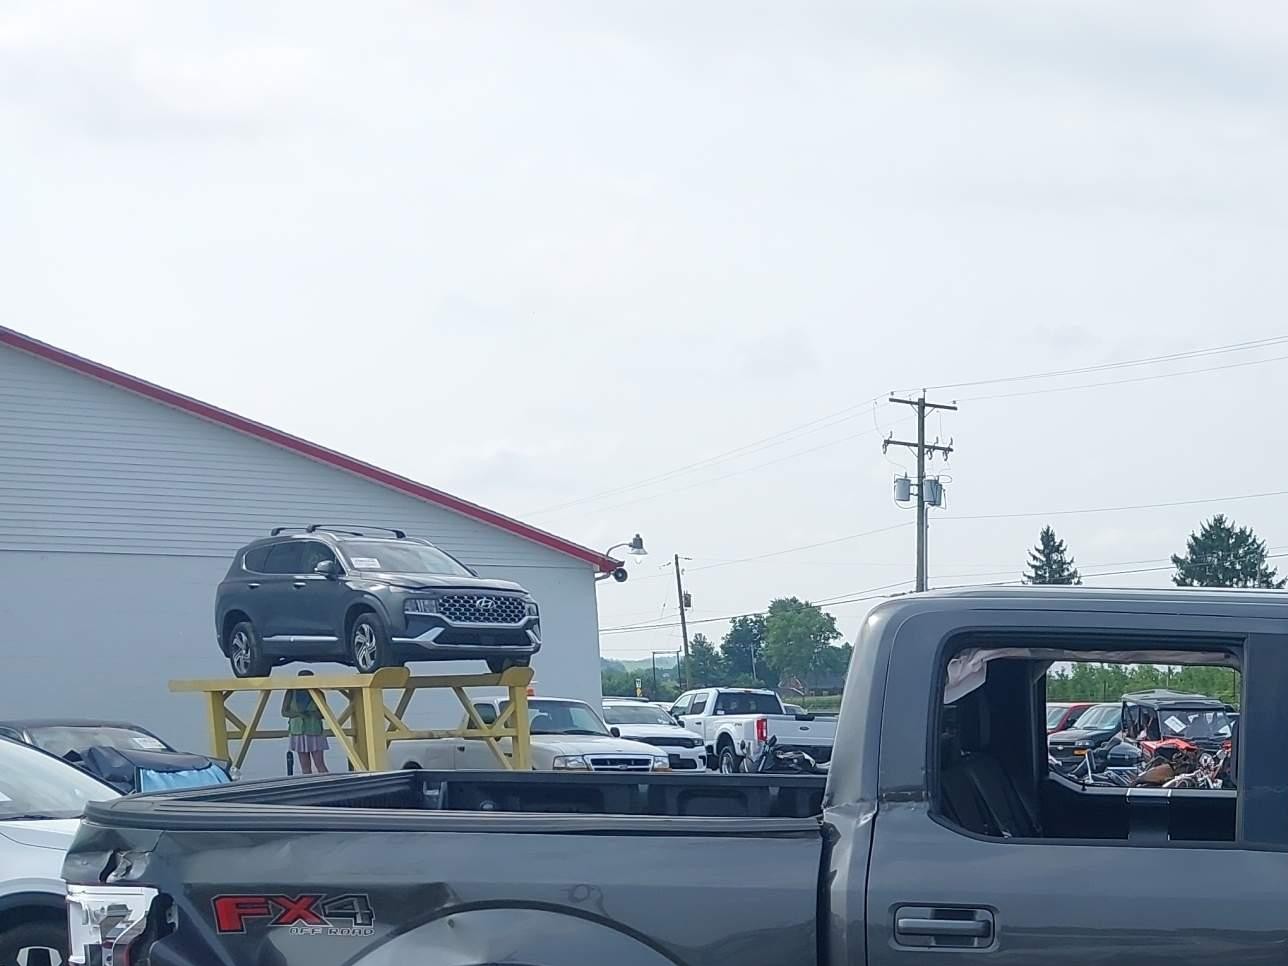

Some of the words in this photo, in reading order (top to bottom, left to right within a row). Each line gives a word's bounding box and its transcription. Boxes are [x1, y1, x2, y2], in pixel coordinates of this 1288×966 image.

[211, 893, 376, 935] FX4
[288, 926, 323, 937] OFF
[327, 926, 376, 937] ROAD
